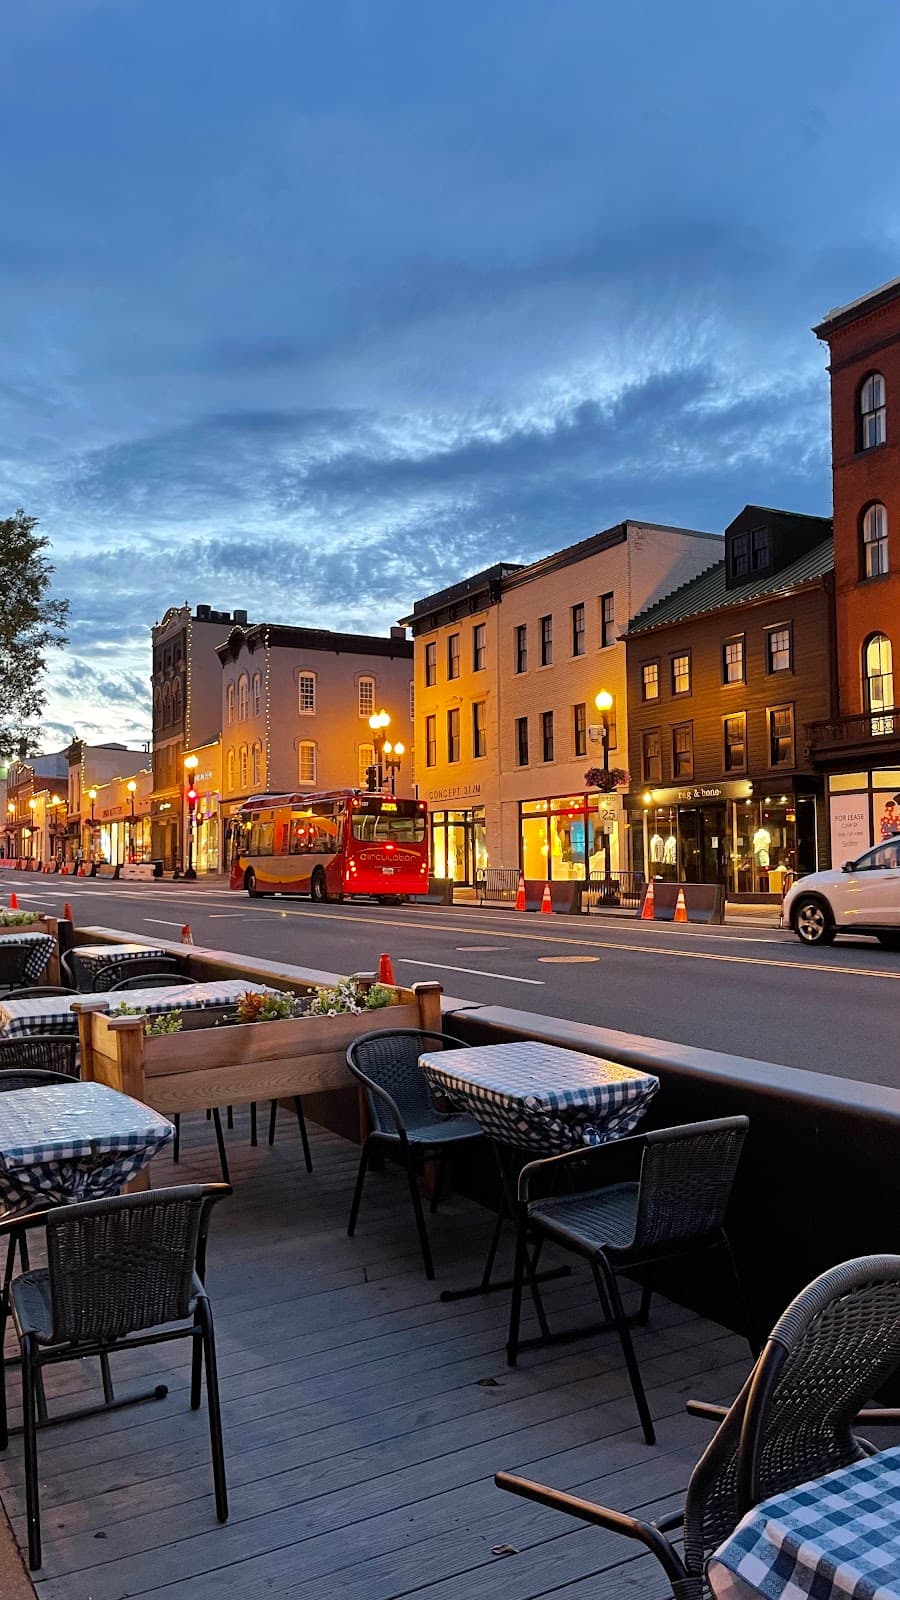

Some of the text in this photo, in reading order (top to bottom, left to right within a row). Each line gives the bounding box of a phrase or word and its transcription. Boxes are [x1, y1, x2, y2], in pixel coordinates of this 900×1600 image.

[429, 787, 460, 799] CONCEPT
[693, 789, 700, 797] &
[602, 809, 615, 820] 25
[847, 813, 865, 821] LEASE
